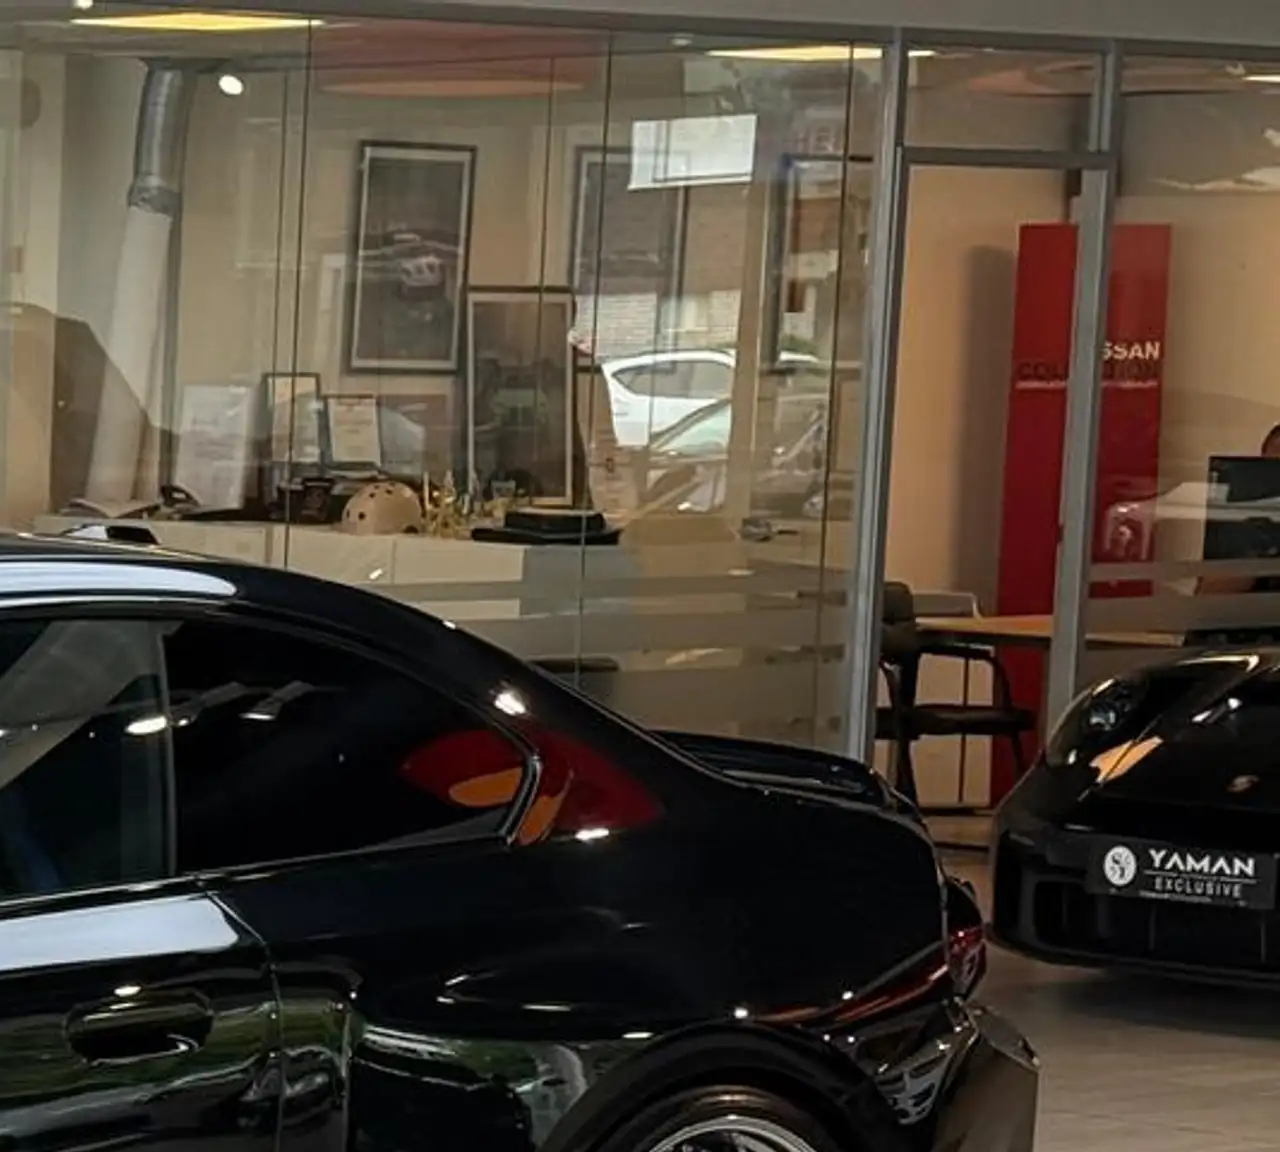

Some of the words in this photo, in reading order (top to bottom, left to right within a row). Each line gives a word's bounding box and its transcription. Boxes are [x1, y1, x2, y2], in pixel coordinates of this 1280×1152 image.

[1102, 340, 1161, 361] SSAN
[1147, 848, 1256, 878] YAMAN
[1153, 876, 1243, 899] EXCLUSIVE
